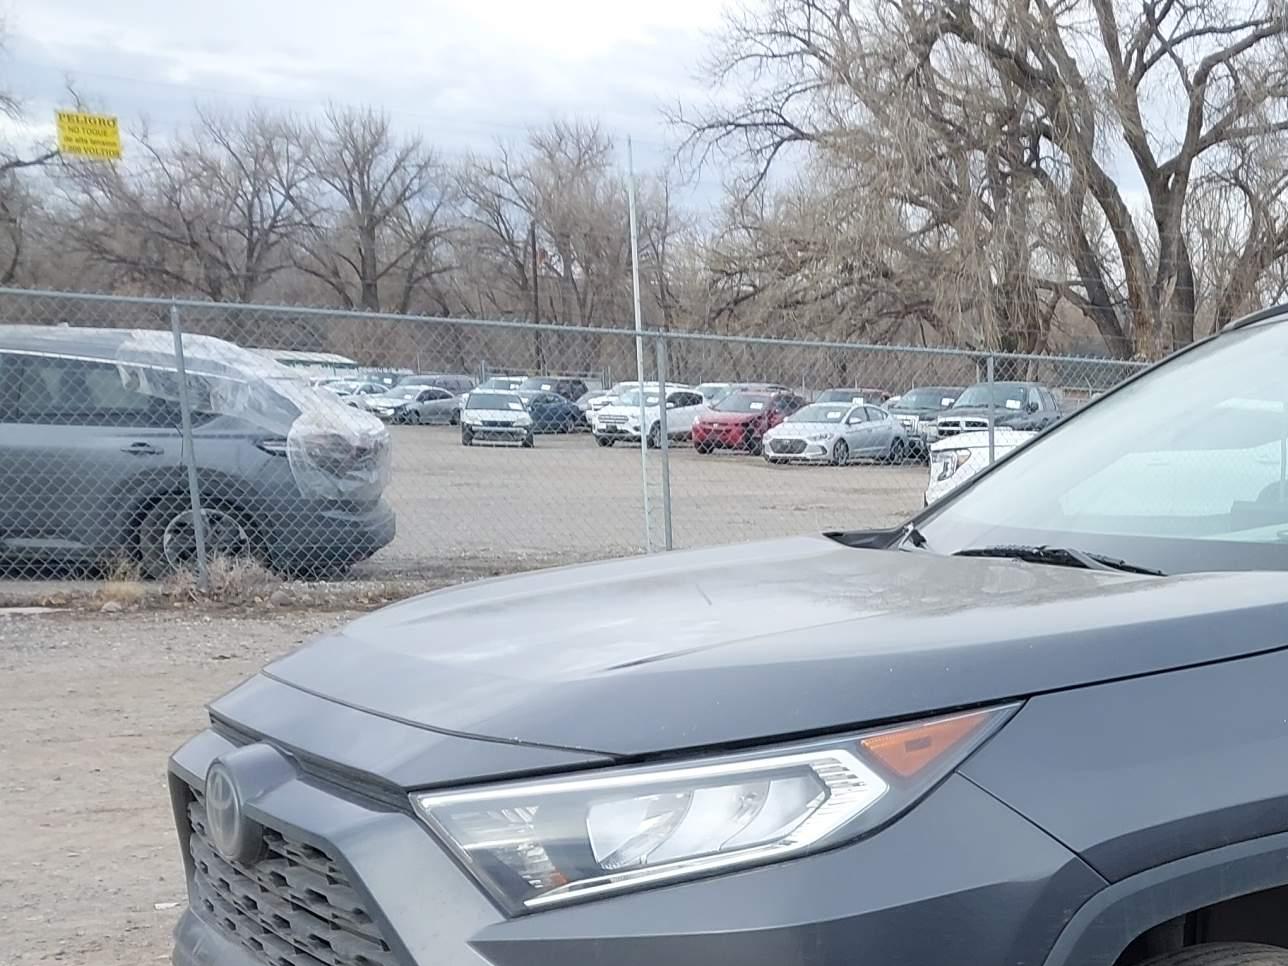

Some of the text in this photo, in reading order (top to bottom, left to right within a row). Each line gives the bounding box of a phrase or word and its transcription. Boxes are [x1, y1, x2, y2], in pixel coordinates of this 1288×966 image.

[58, 112, 116, 128] PELIGRO
[68, 126, 107, 137] NO TOQUE
